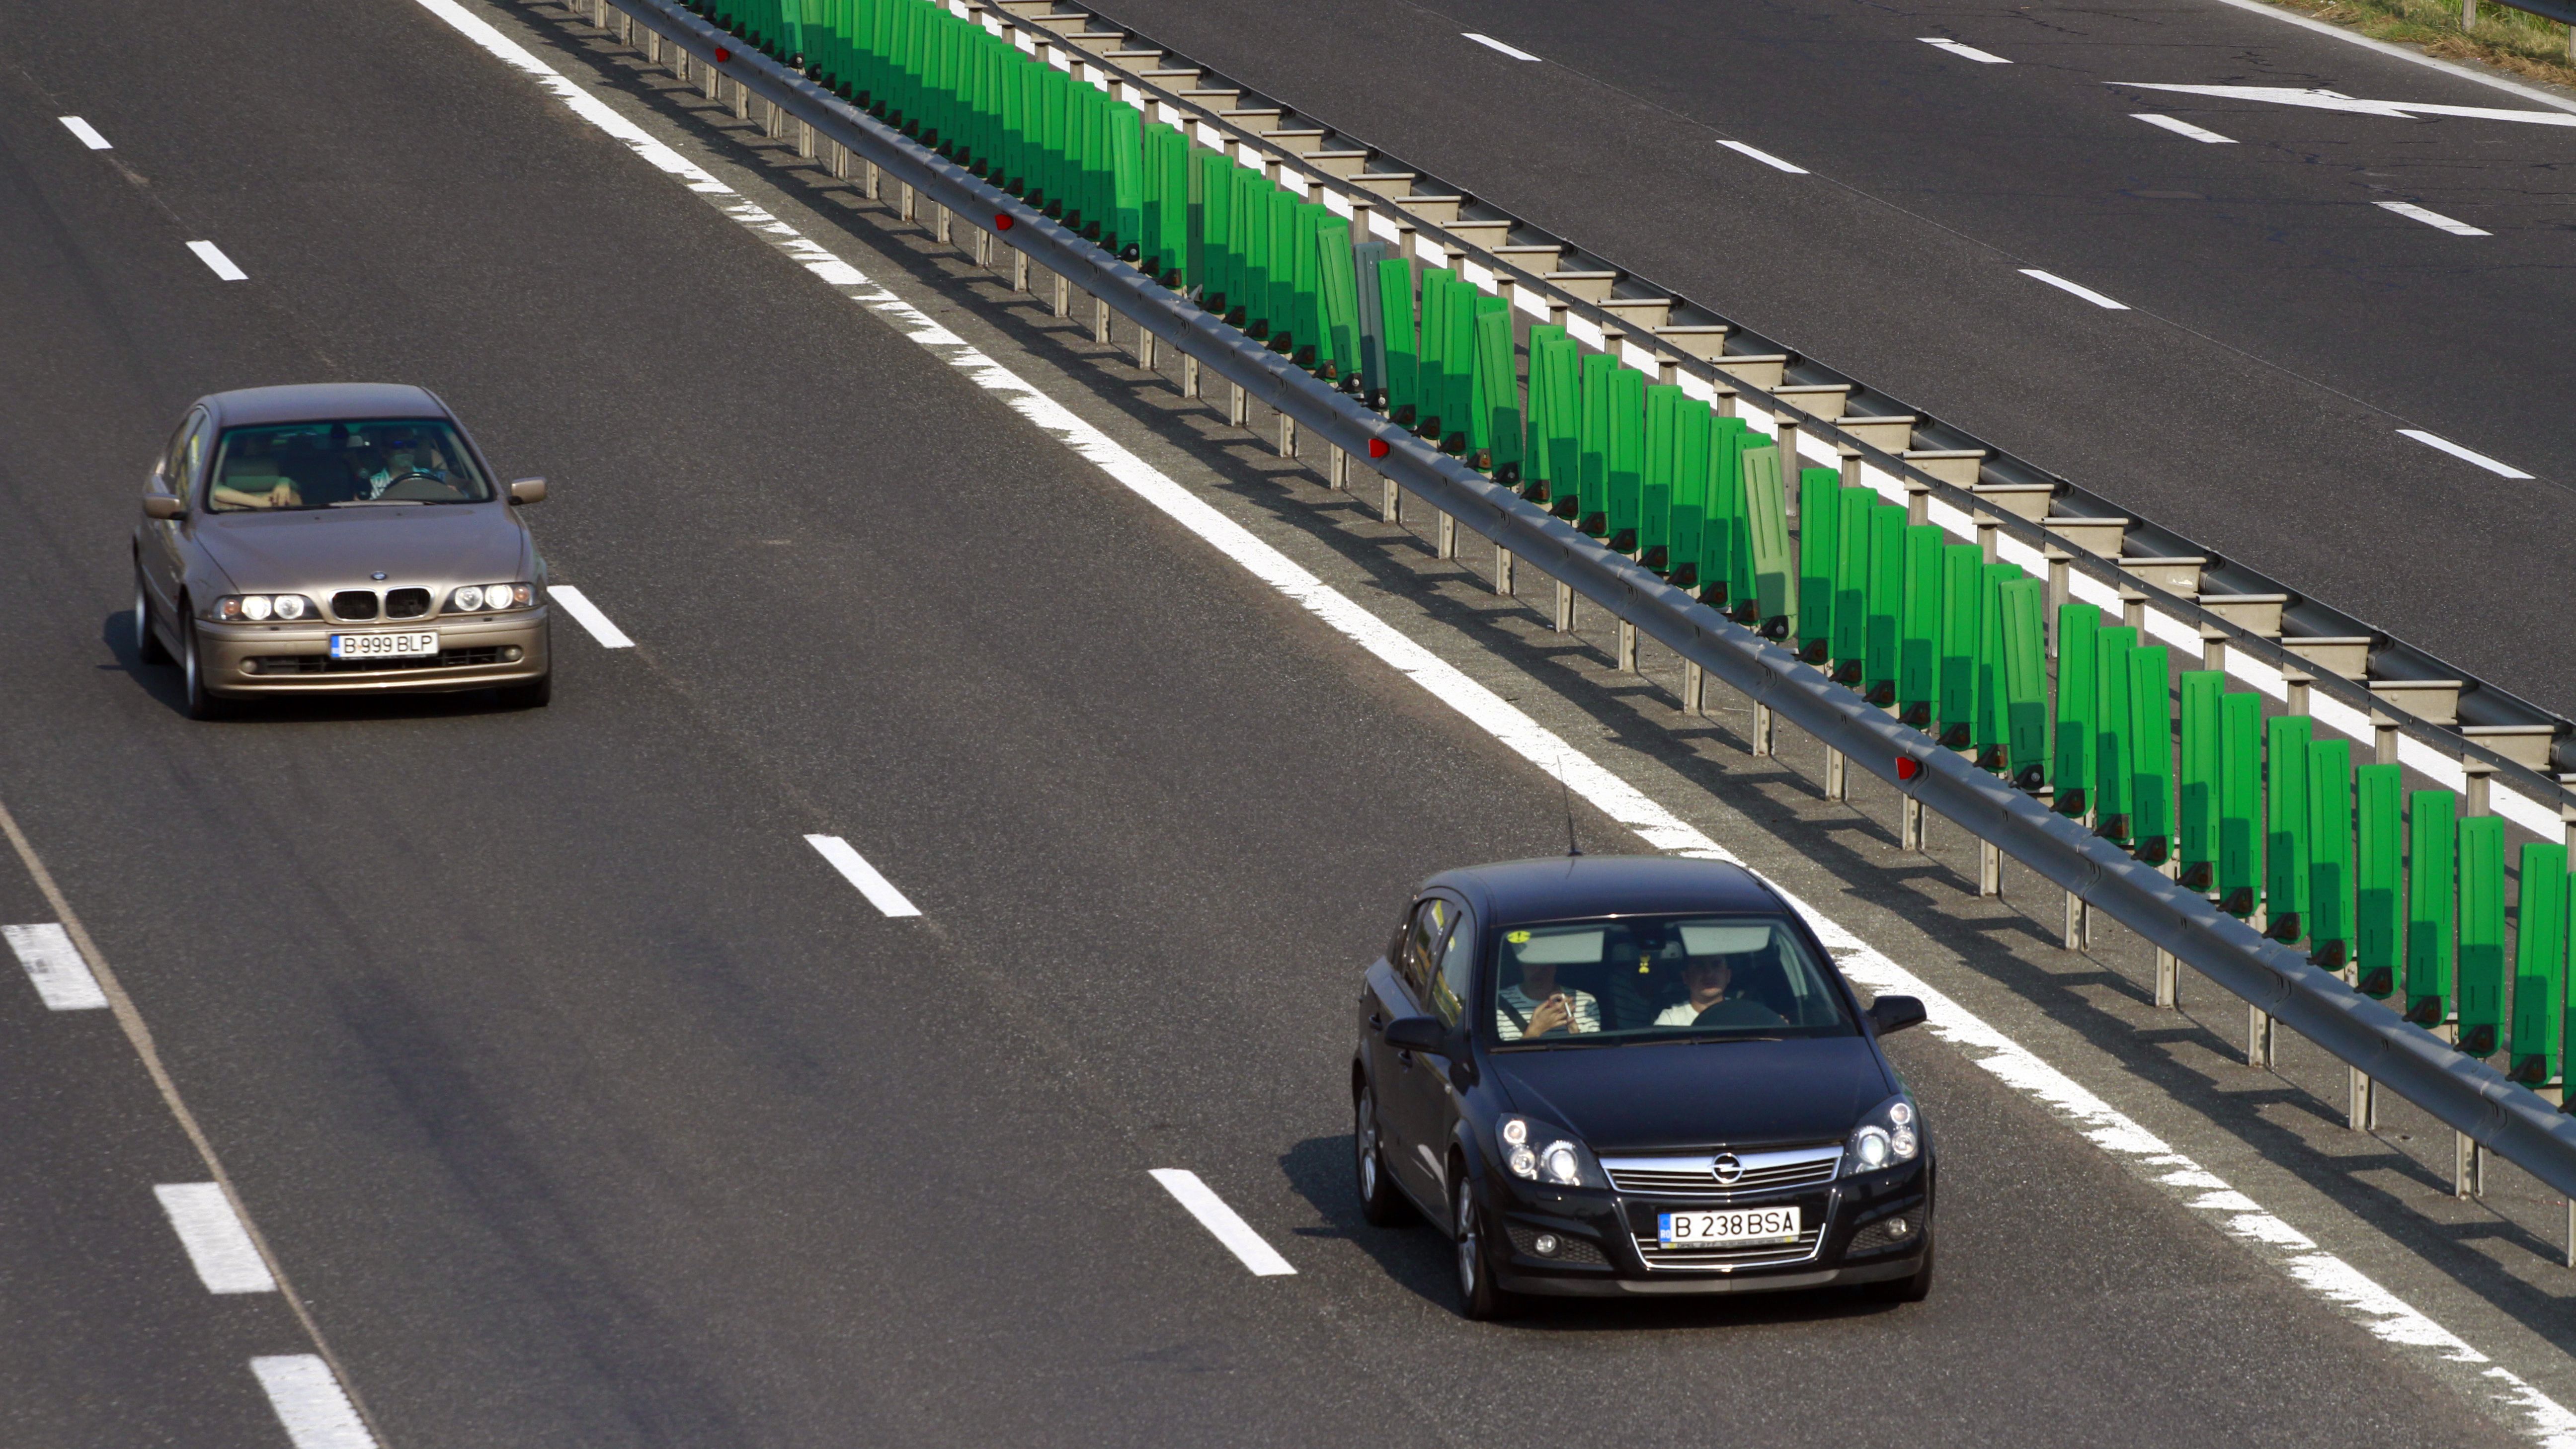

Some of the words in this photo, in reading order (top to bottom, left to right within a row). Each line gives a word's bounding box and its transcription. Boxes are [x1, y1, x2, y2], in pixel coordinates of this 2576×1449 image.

[344, 638, 356, 653] B
[361, 637, 392, 653] 999
[398, 635, 432, 652] BLP
[1675, 1217, 1691, 1237] B
[1701, 1214, 1743, 1236] 238
[1748, 1211, 1793, 1235] BSA
[1660, 1229, 1670, 1239] RO
